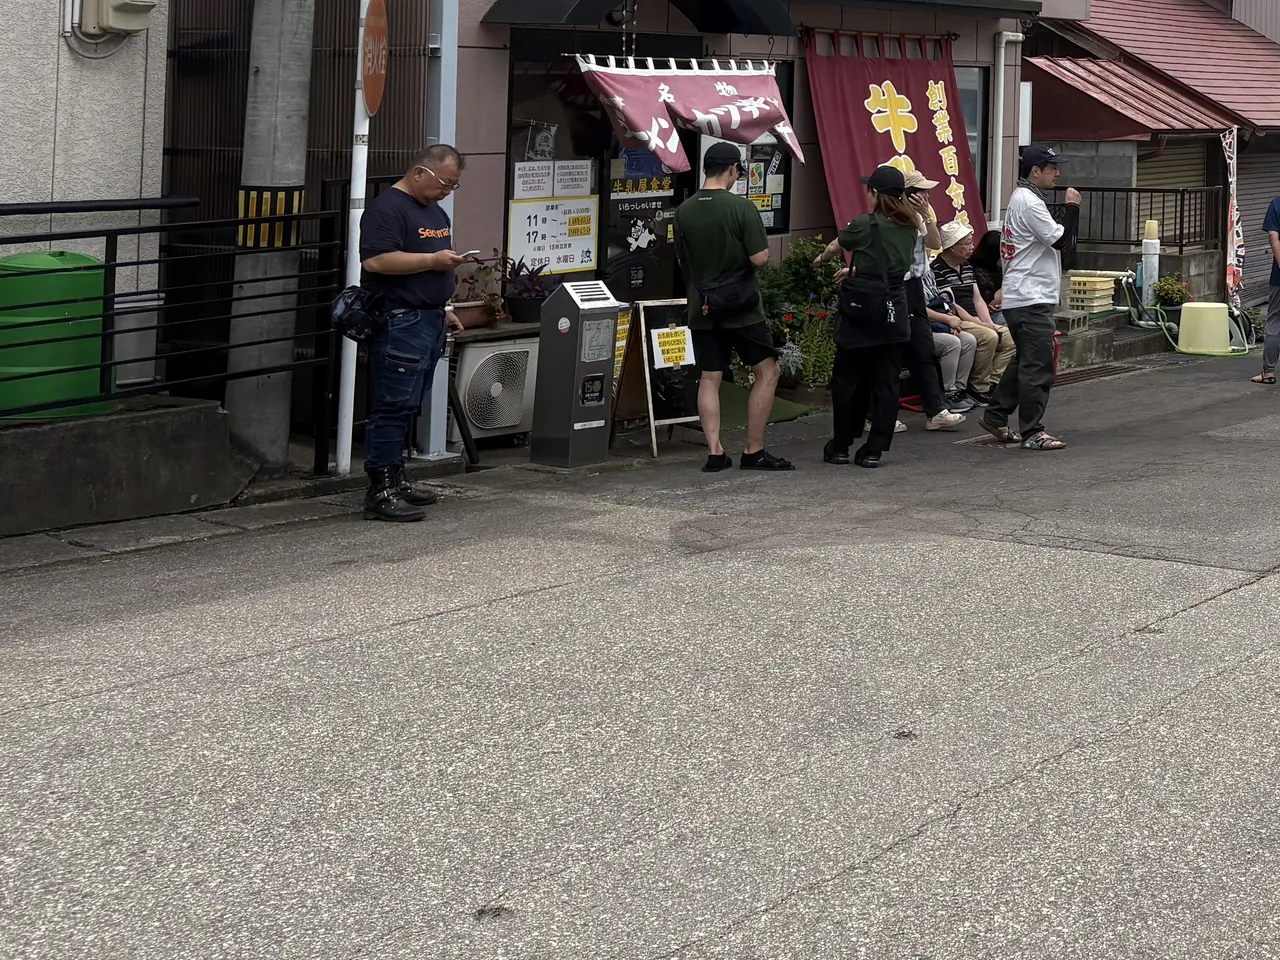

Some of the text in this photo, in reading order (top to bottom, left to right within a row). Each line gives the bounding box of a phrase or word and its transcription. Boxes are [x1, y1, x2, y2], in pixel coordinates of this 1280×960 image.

[364, 36, 387, 75] 消火栓
[613, 176, 672, 195] 牛乳屋食堂
[619, 201, 662, 211] いらっしゃいませ
[530, 254, 575, 266] 定休日 水曜日
